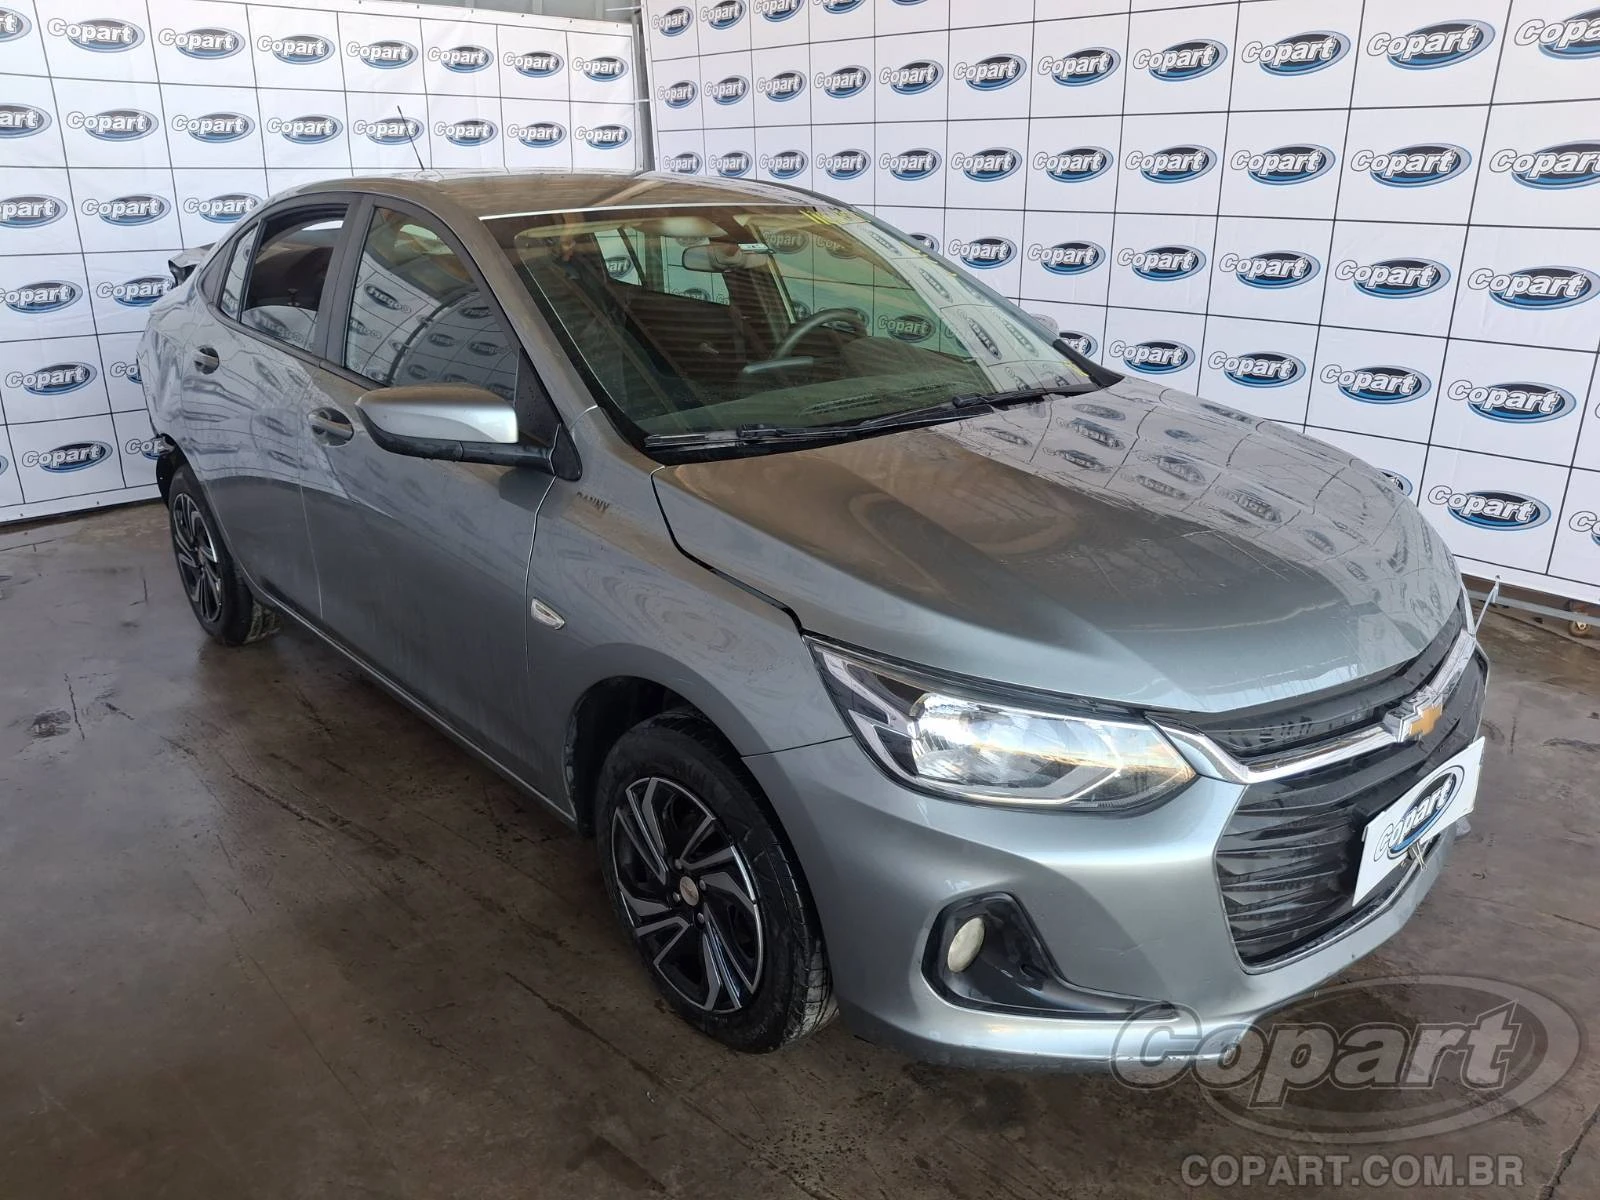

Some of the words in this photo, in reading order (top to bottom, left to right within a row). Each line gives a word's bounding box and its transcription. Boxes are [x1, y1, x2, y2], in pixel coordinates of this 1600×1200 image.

[651, 11, 688, 32] Copart
[700, 2, 740, 25] Copart
[47, 18, 134, 44] Copart
[159, 28, 235, 51] Copart
[257, 36, 326, 56] Copart
[346, 41, 410, 62] Copart
[1241, 36, 1337, 67] Copart
[1367, 25, 1480, 61] Copart
[428, 47, 486, 66] Copart
[503, 52, 556, 71] Copart
[572, 57, 622, 75] Copart
[1038, 51, 1110, 80] Copart
[1133, 43, 1216, 74] Copart
[814, 70, 863, 90] Copart
[879, 64, 936, 88] Copart
[953, 58, 1018, 84] Copart
[657, 83, 693, 103] Copart
[704, 79, 743, 99] Copart
[756, 75, 801, 96] Copart
[66, 111, 147, 134] Copart
[172, 115, 245, 136] Copart
[267, 117, 333, 137] Copart
[353, 120, 417, 139] Copart
[434, 121, 491, 140] Copart
[507, 124, 560, 142] Copart
[574, 126, 626, 144] Copart
[663, 154, 698, 172] Copart
[708, 154, 747, 173] Copart
[760, 153, 802, 172] Copart
[816, 153, 864, 173] Copart
[879, 152, 935, 173] Copart
[951, 151, 1014, 174] Copart
[1033, 151, 1104, 175] Copart
[1125, 150, 1206, 175] Copart
[1231, 149, 1323, 175] Copart
[1350, 149, 1457, 178] Copart
[0, 198, 55, 220] part
[81, 198, 161, 219] Copart
[183, 197, 255, 217] Copart
[949, 239, 1010, 261] Copart
[1027, 242, 1096, 265] Copart
[1118, 248, 1196, 272] Copart
[1219, 253, 1308, 278] Copart
[1335, 259, 1436, 288] Copart
[1468, 268, 1586, 300] Copart
[878, 315, 930, 337] Copart
[1109, 339, 1185, 365] Copart
[1208, 351, 1295, 379] Copart
[5, 364, 87, 390] Copart
[1320, 364, 1420, 394] Copart
[1447, 379, 1566, 413] Copart
[22, 443, 101, 468] Copart
[1428, 484, 1537, 523] Copart
[1373, 773, 1455, 862] Copart
